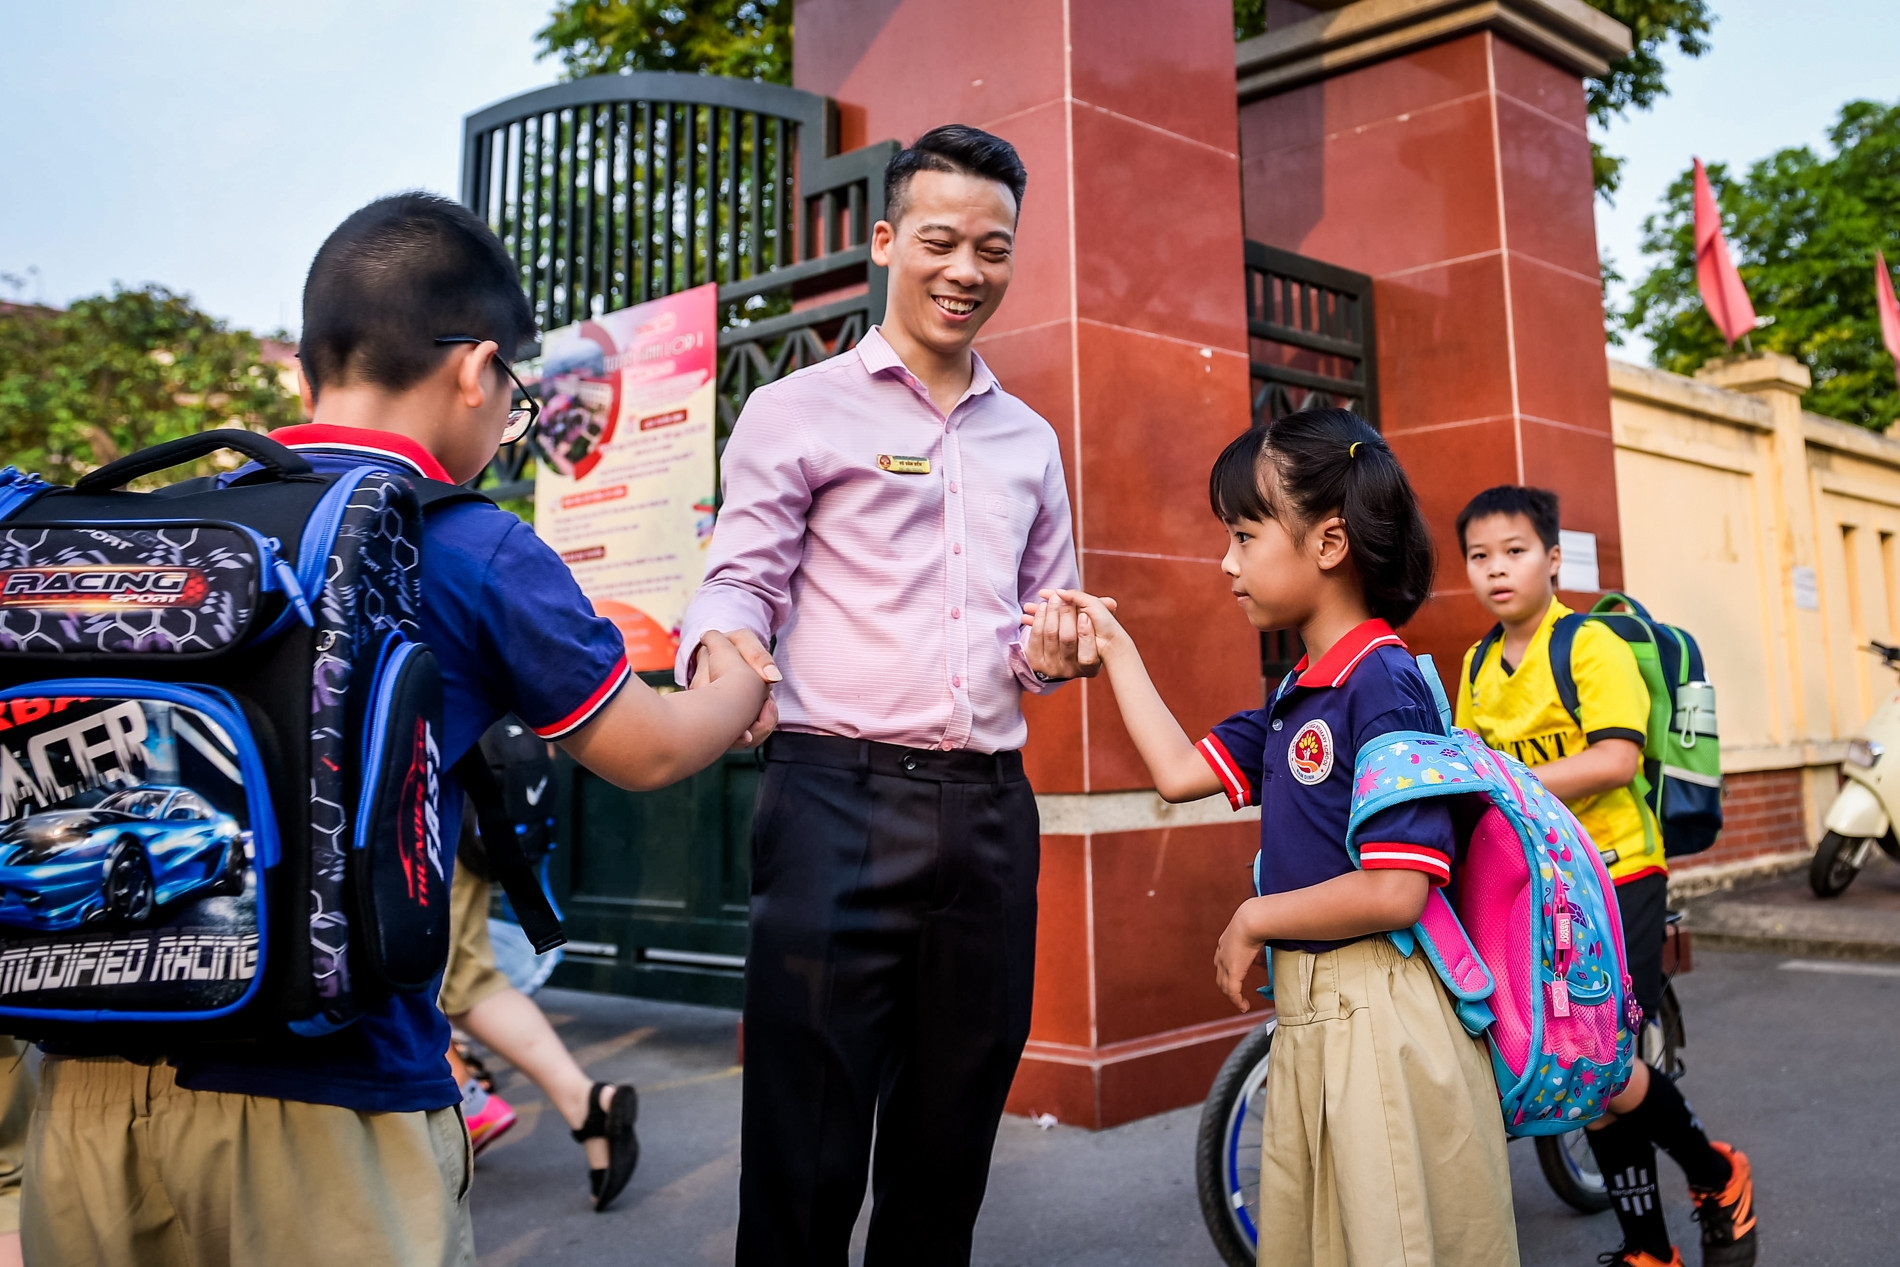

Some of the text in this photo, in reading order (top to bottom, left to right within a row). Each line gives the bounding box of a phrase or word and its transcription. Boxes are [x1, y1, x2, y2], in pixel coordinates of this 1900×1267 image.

[3, 572, 188, 594] RACING
[109, 593, 183, 603] SPORT
[424, 720, 444, 881] FAST
[150, 933, 259, 982] RACING
